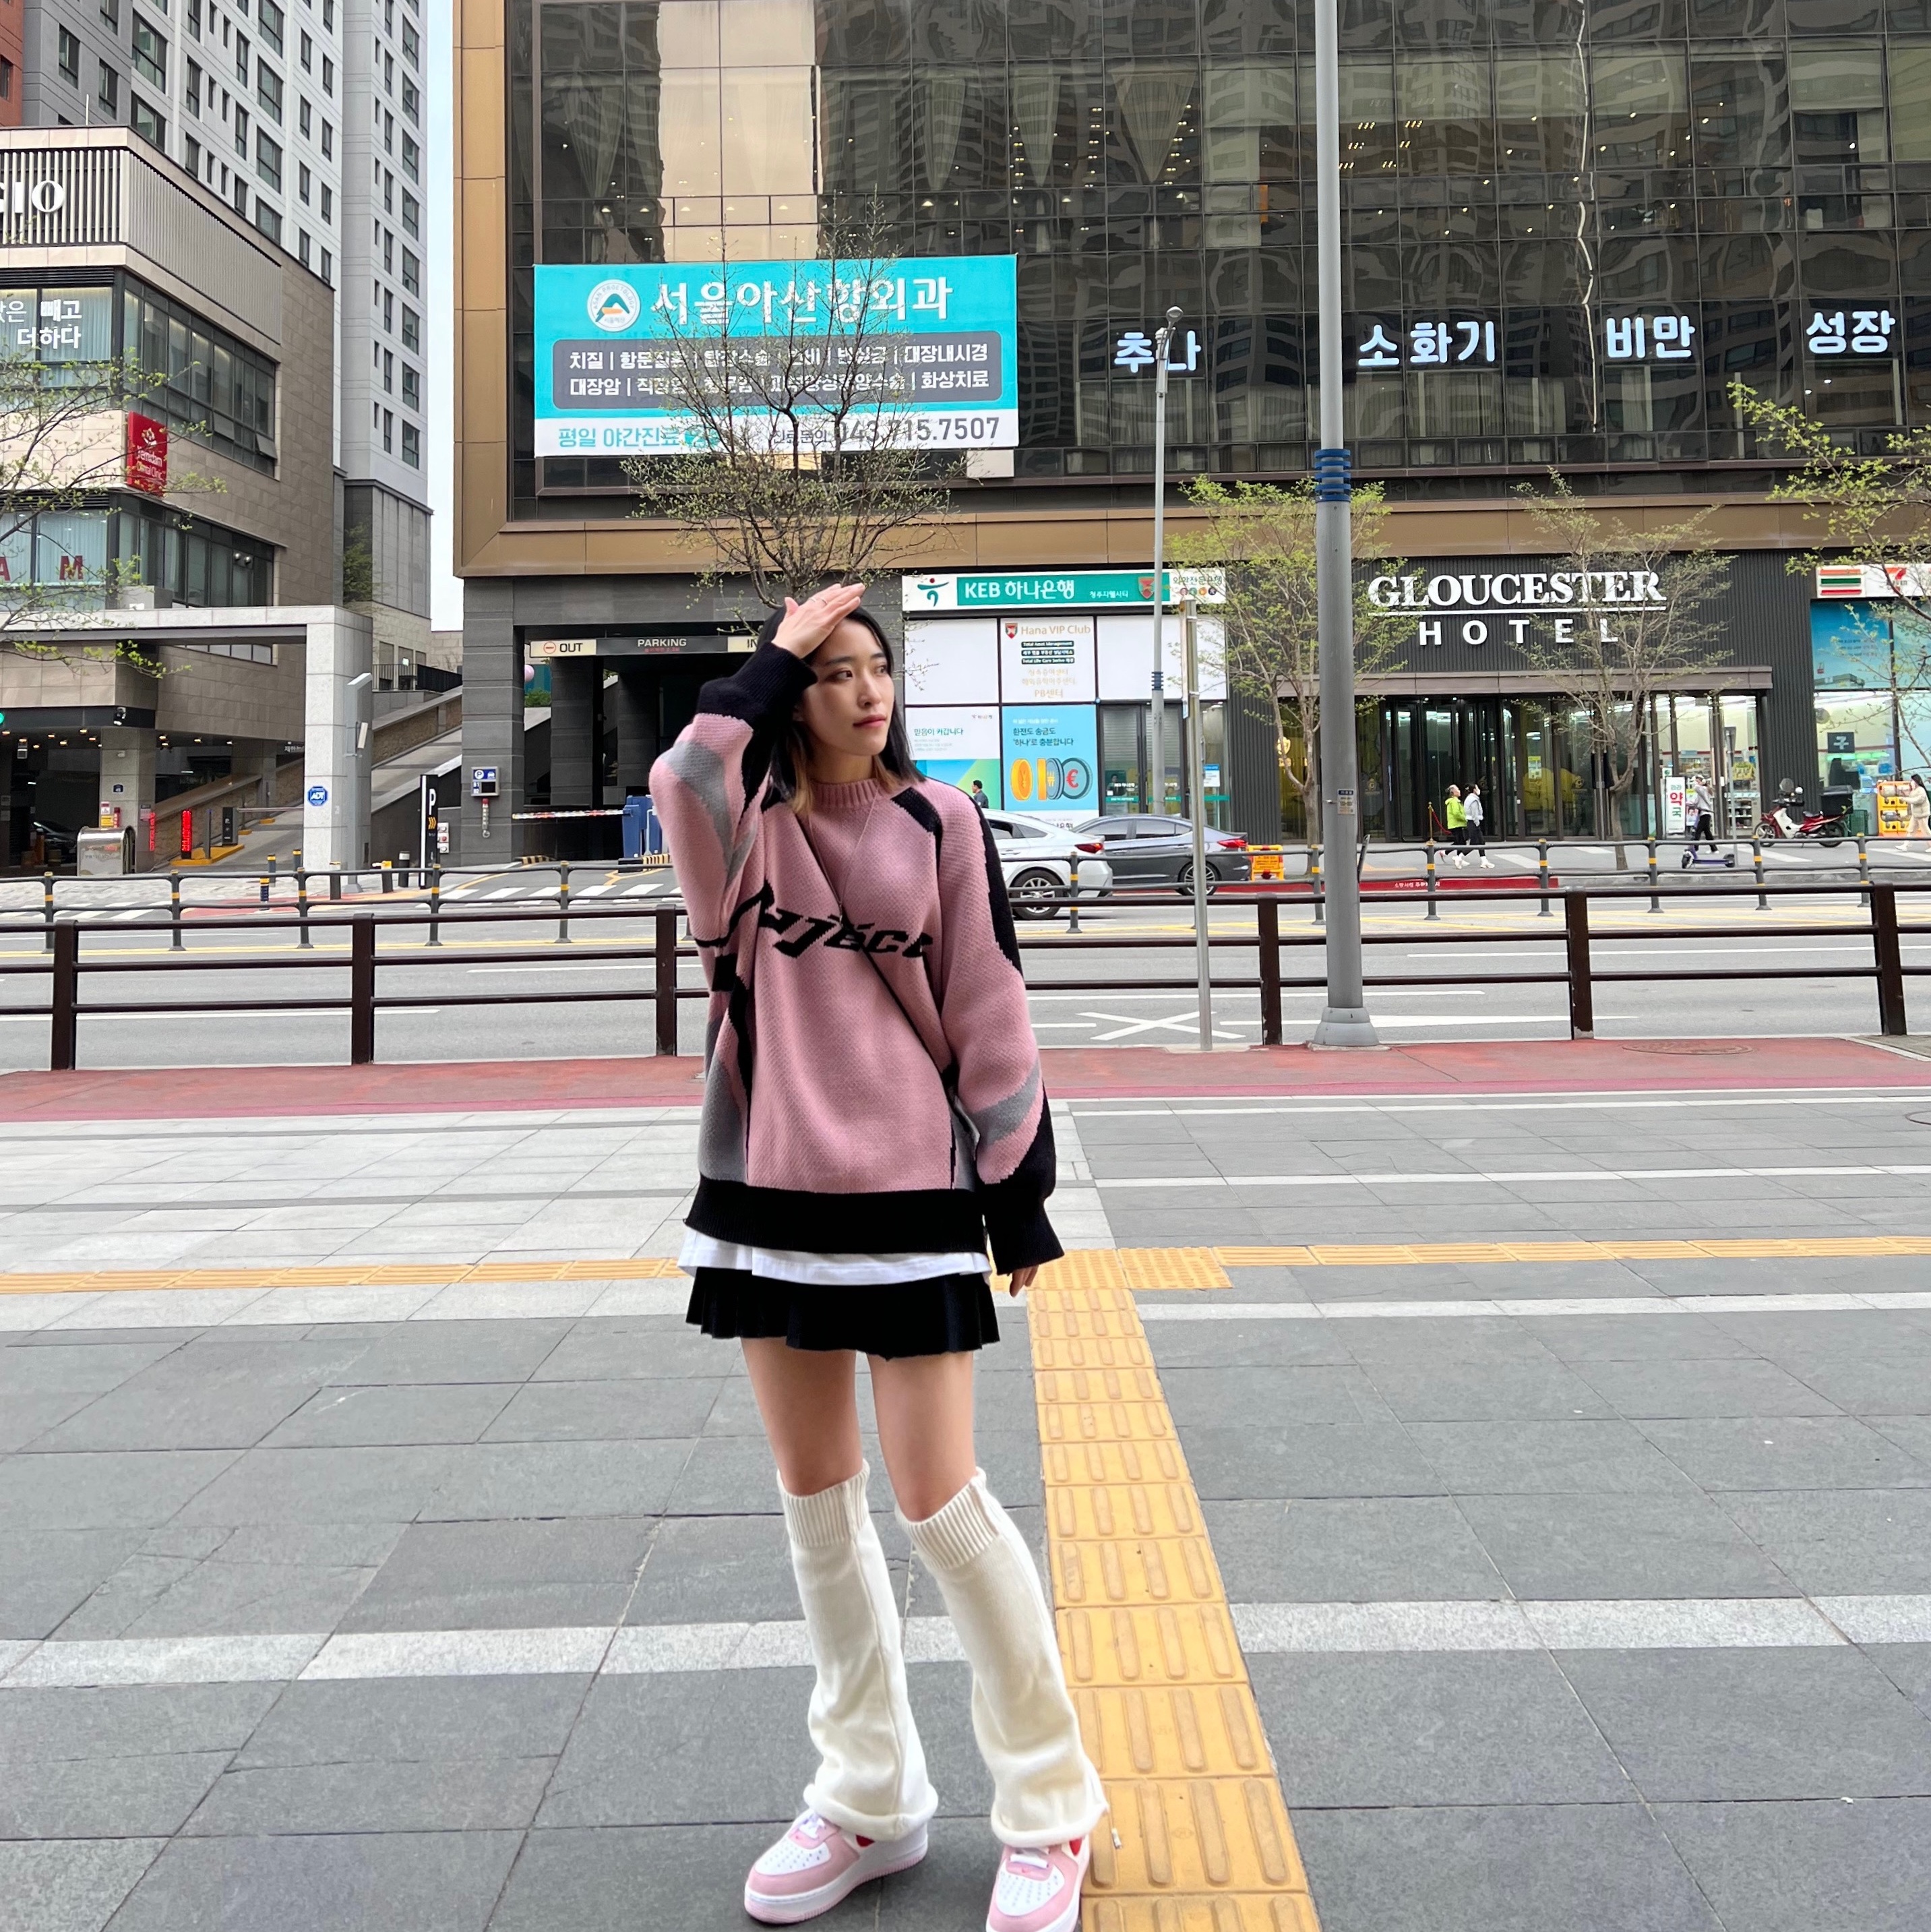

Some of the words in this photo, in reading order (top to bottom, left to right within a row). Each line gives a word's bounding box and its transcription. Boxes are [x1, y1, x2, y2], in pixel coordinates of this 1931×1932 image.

[0, 180, 65, 213] IO
[40, 299, 82, 322] 빼고
[650, 276, 953, 325] 서울아산항외과
[17, 326, 82, 350] 더하다
[1114, 332, 1201, 372] 추나
[1357, 321, 1495, 367] 소화기
[1606, 315, 1696, 359] 비만
[1806, 309, 1896, 354] 성장
[570, 351, 603, 369] 치질
[904, 344, 987, 363] 대장내시경
[570, 378, 621, 396] 대장암
[921, 370, 989, 389] 화상치료
[559, 427, 596, 448] 평일
[603, 427, 679, 447] 야간진료
[964, 582, 1001, 599] KEB
[1005, 580, 1075, 600] 하나은행
[1368, 571, 1667, 607] GLOUCESTER
[1021, 626, 1047, 635] Hana
[1049, 626, 1065, 634] VIP
[1067, 625, 1091, 634] Club
[1419, 618, 1618, 646] HOTEL
[559, 642, 583, 653] OUT
[637, 638, 687, 647] PARKING
[746, 639, 758, 648] IN
[311, 791, 325, 800] ADT
[429, 788, 437, 815] P
